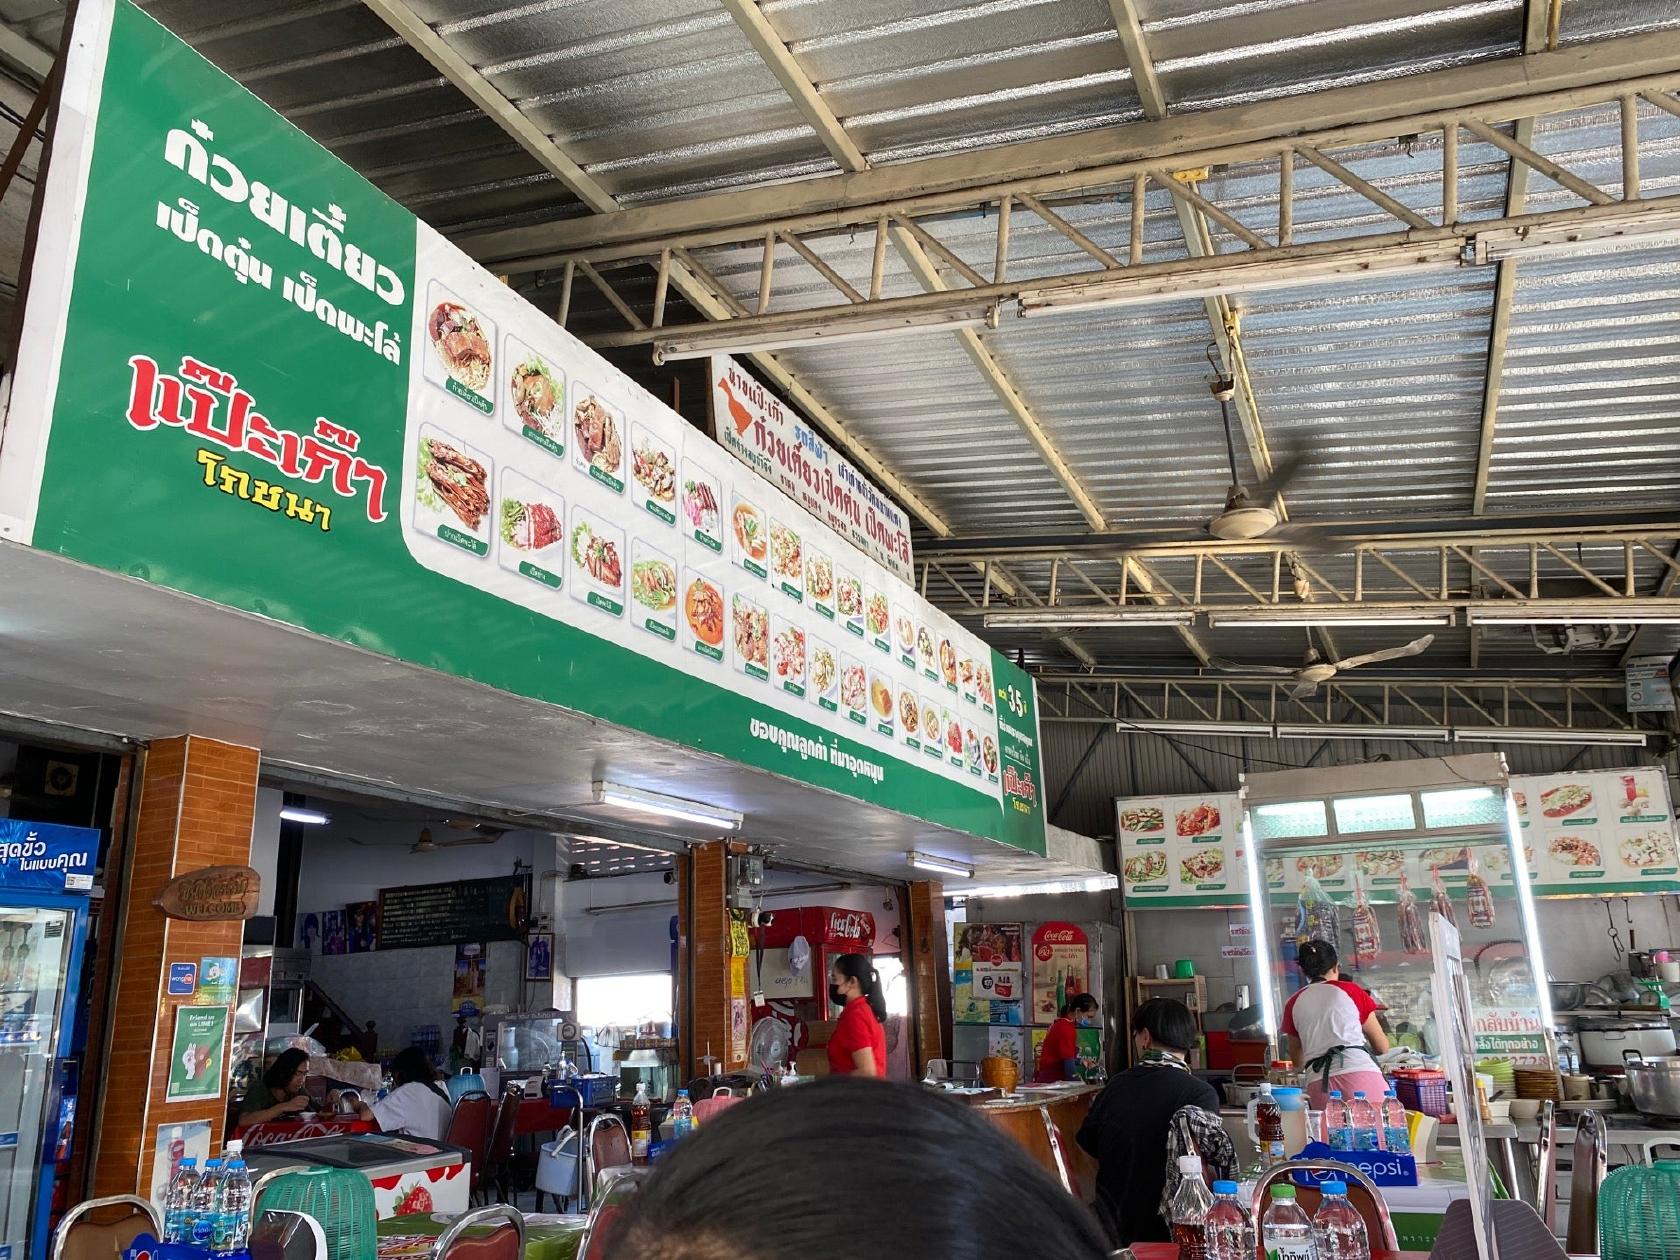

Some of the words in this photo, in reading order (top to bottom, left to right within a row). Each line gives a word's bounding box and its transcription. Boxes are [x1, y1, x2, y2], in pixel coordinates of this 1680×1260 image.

[164, 119, 405, 305] ก๋วยเตี๋ยว
[156, 197, 273, 290] เป็ดตุ๋น
[283, 270, 401, 366] เป็ดพะโล้
[197, 448, 332, 531] โภชนา
[1007, 684, 1024, 717] 35
[749, 717, 827, 761] ขอบคุณลูกค้า
[830, 738, 884, 784] ที่มาอุดหนุน
[0, 831, 47, 864] สุดขั้ว
[20, 852, 88, 873] ในแบบคุณ
